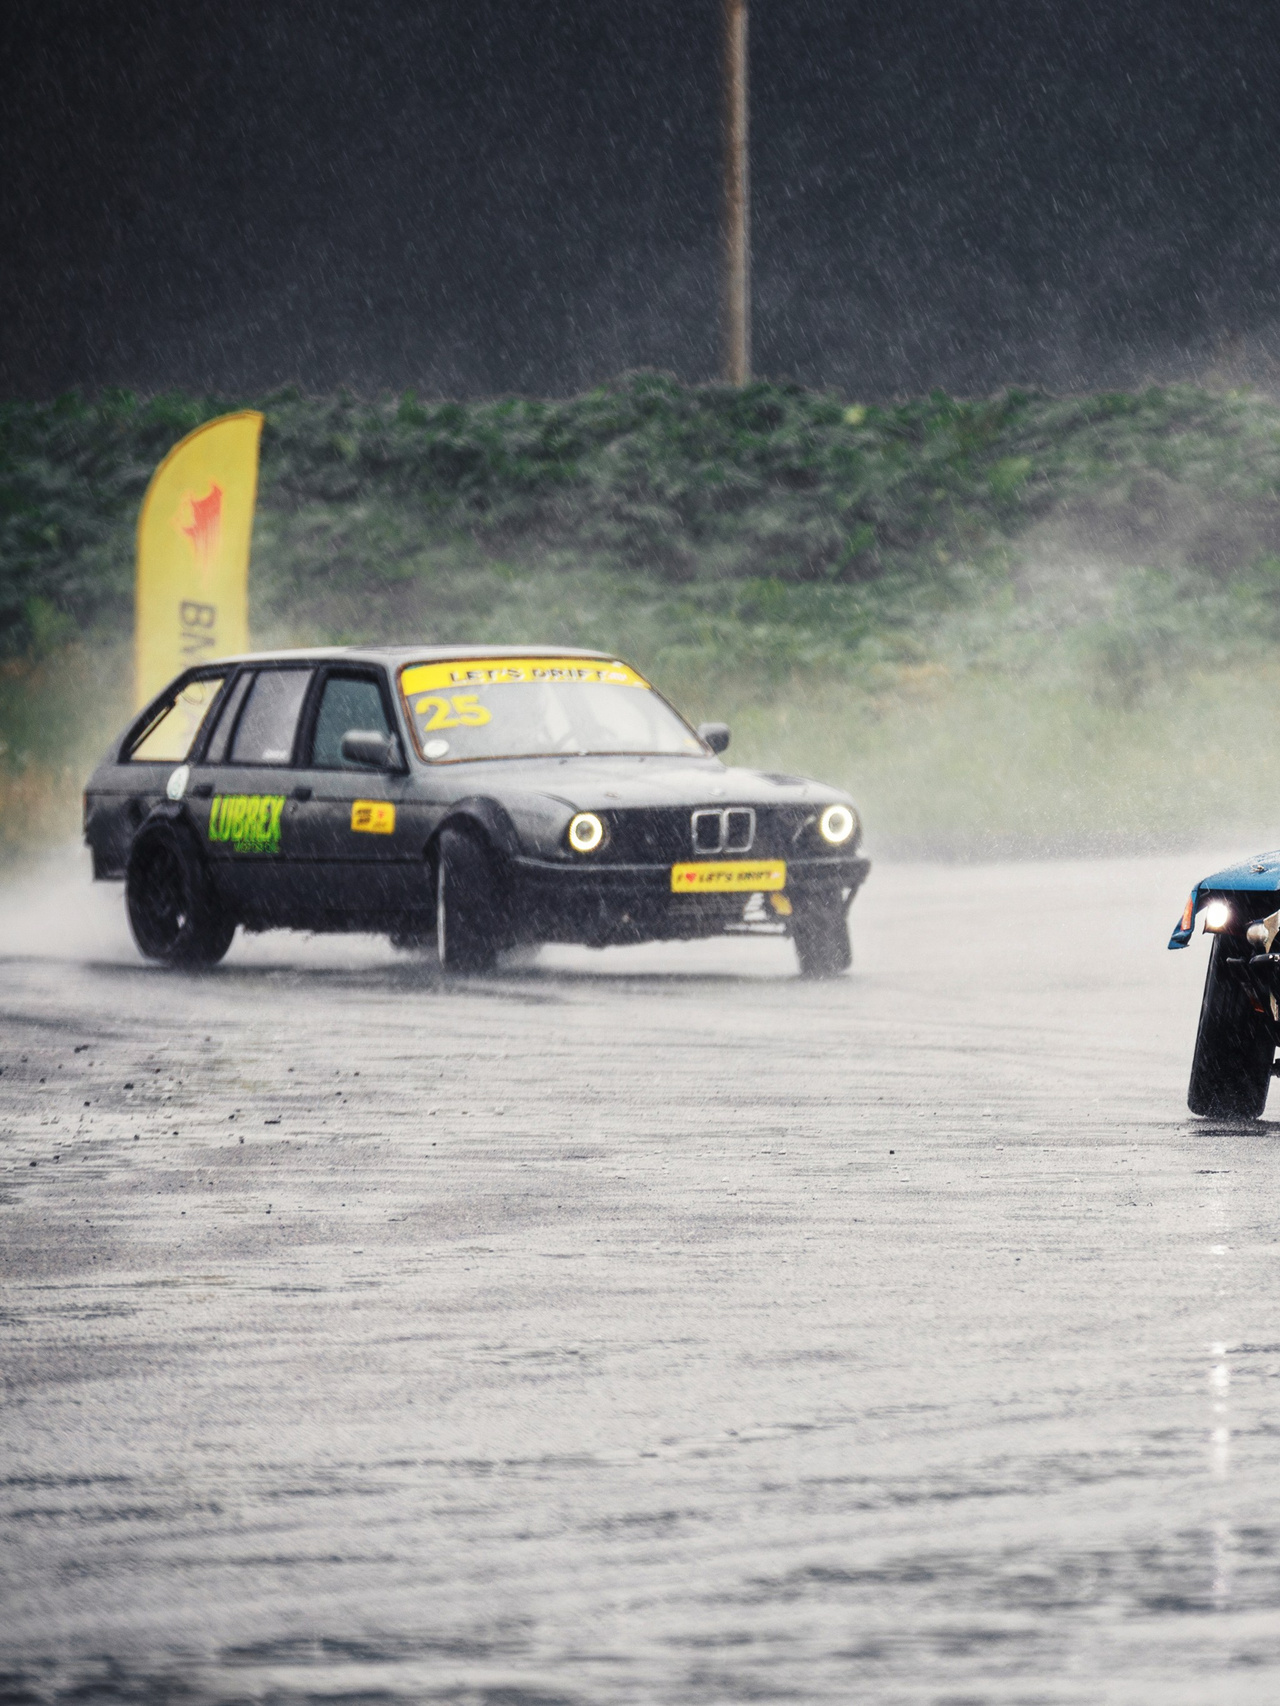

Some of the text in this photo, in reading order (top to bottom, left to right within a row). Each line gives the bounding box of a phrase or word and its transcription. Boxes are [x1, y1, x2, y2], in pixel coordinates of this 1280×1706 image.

[450, 668, 524, 685] LET'S
[415, 695, 492, 732] 25
[208, 794, 286, 842] LUBREX
